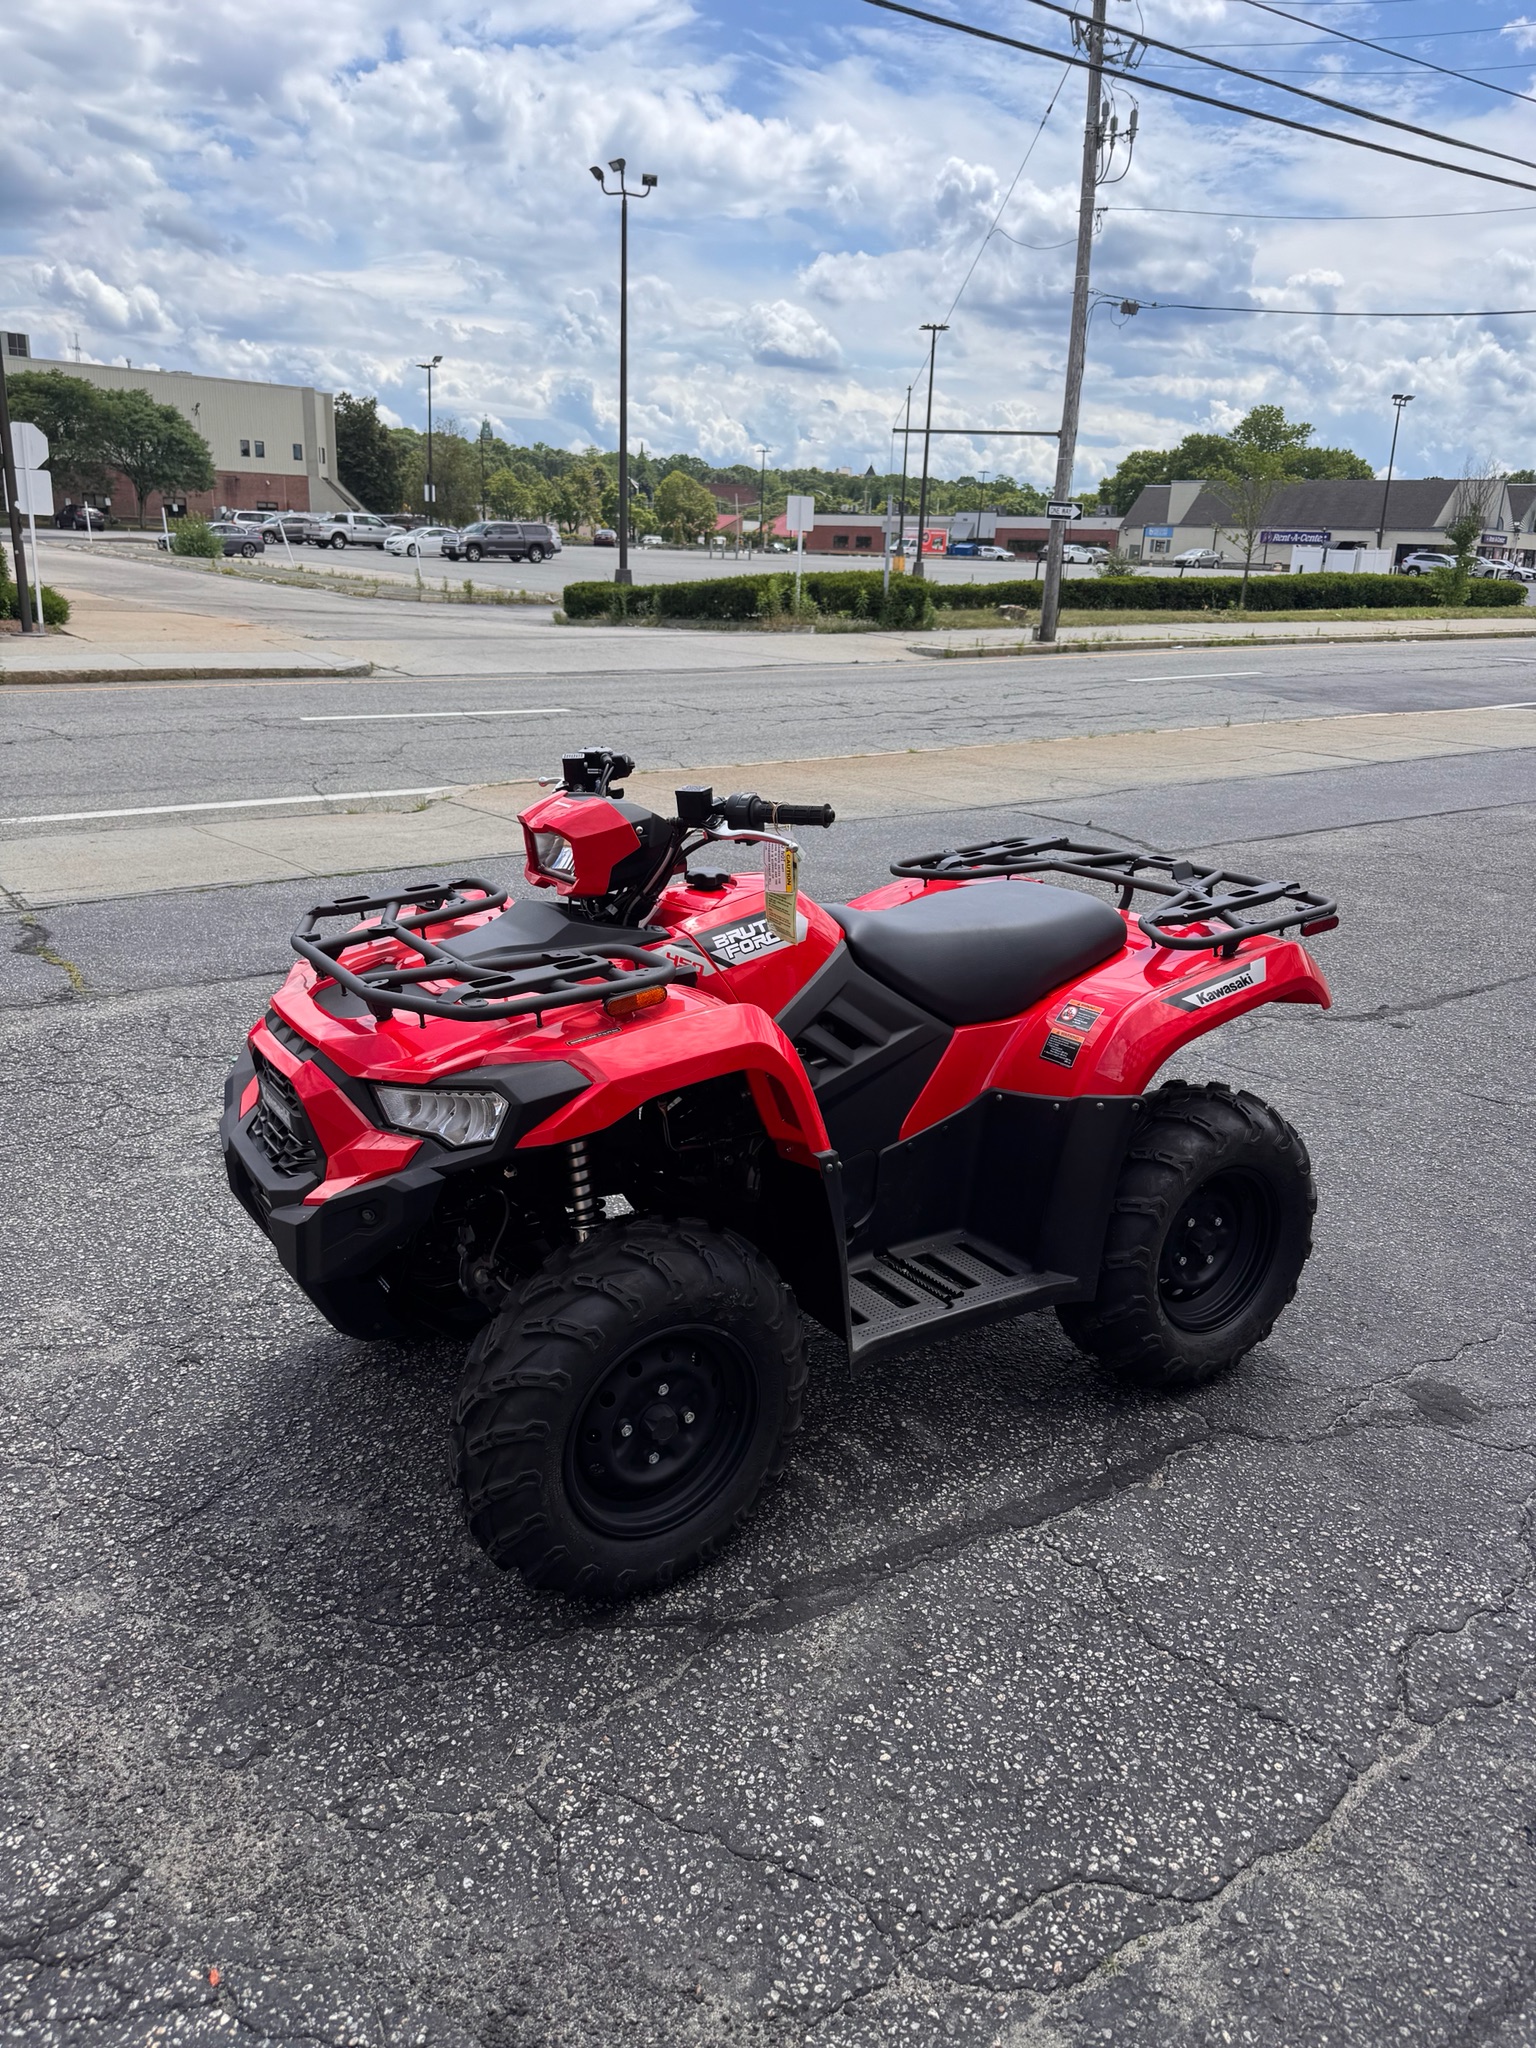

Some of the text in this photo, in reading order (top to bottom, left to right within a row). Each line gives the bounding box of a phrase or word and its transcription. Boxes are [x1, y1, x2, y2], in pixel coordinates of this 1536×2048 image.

[1273, 533, 1327, 543] Rent-A-Cente
[712, 919, 767, 949] BRUT
[725, 931, 781, 960] FORC
[1196, 973, 1254, 1005] Kawasaki
